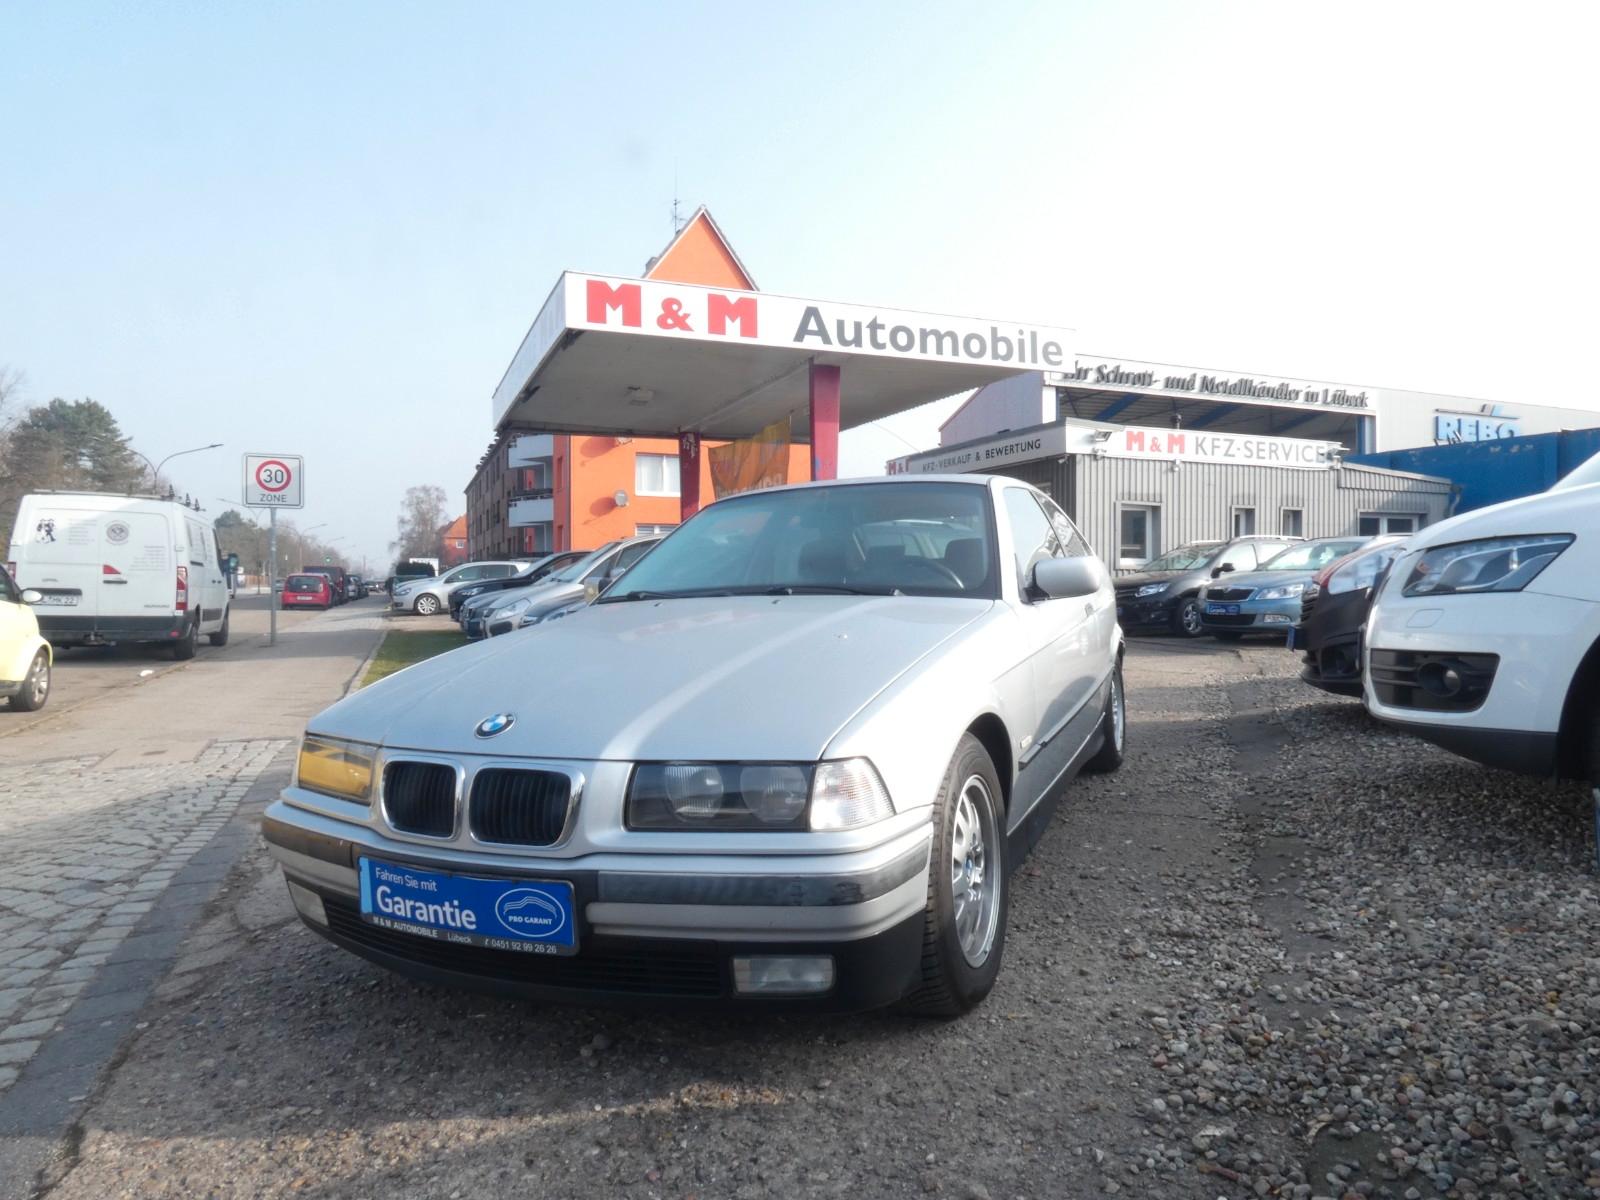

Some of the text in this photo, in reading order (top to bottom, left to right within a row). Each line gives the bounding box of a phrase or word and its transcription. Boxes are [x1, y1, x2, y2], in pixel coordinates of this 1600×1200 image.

[586, 279, 1063, 367] M & M Automobile
[1164, 373, 1197, 391] und
[1199, 375, 1301, 401] Metallhändler
[1304, 385, 1320, 402] in
[1322, 388, 1369, 408] Lübeck
[985, 439, 1041, 460] BEWERTUNG
[1126, 431, 1144, 451] M
[1150, 437, 1162, 452] &
[1167, 433, 1185, 454] M
[263, 468, 284, 484] 30
[260, 494, 287, 502] ZONE
[375, 867, 437, 892] Fahren Sie mit
[376, 885, 477, 930] Garantie
[393, 921, 439, 938] AUTOMOBILE
[508, 915, 553, 925] PRO GARANT
[491, 939, 509, 950] 0451
